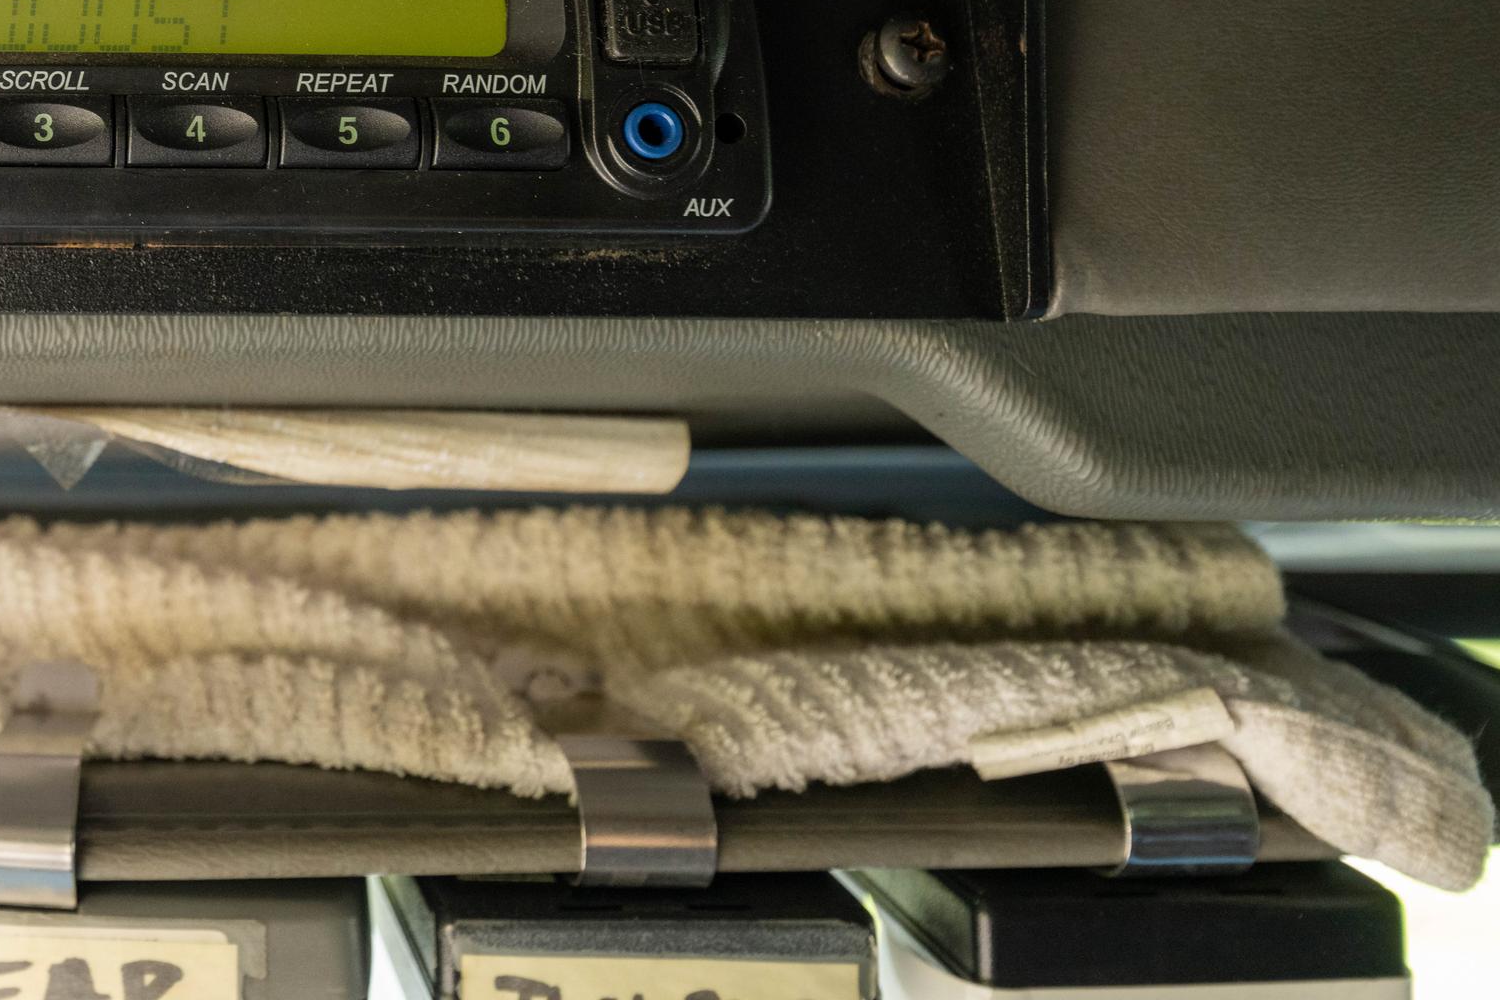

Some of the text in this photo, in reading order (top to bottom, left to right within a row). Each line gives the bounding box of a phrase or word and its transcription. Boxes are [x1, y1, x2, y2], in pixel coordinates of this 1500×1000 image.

[0, 71, 89, 92] SCROLL
[162, 72, 229, 92] SCAN
[296, 73, 393, 94] REPEAT
[442, 74, 547, 95] RANDOM
[34, 115, 54, 142] 3
[186, 115, 206, 143] 4
[338, 117, 358, 144] 5
[490, 118, 511, 146] 6
[684, 199, 734, 218] AUX
